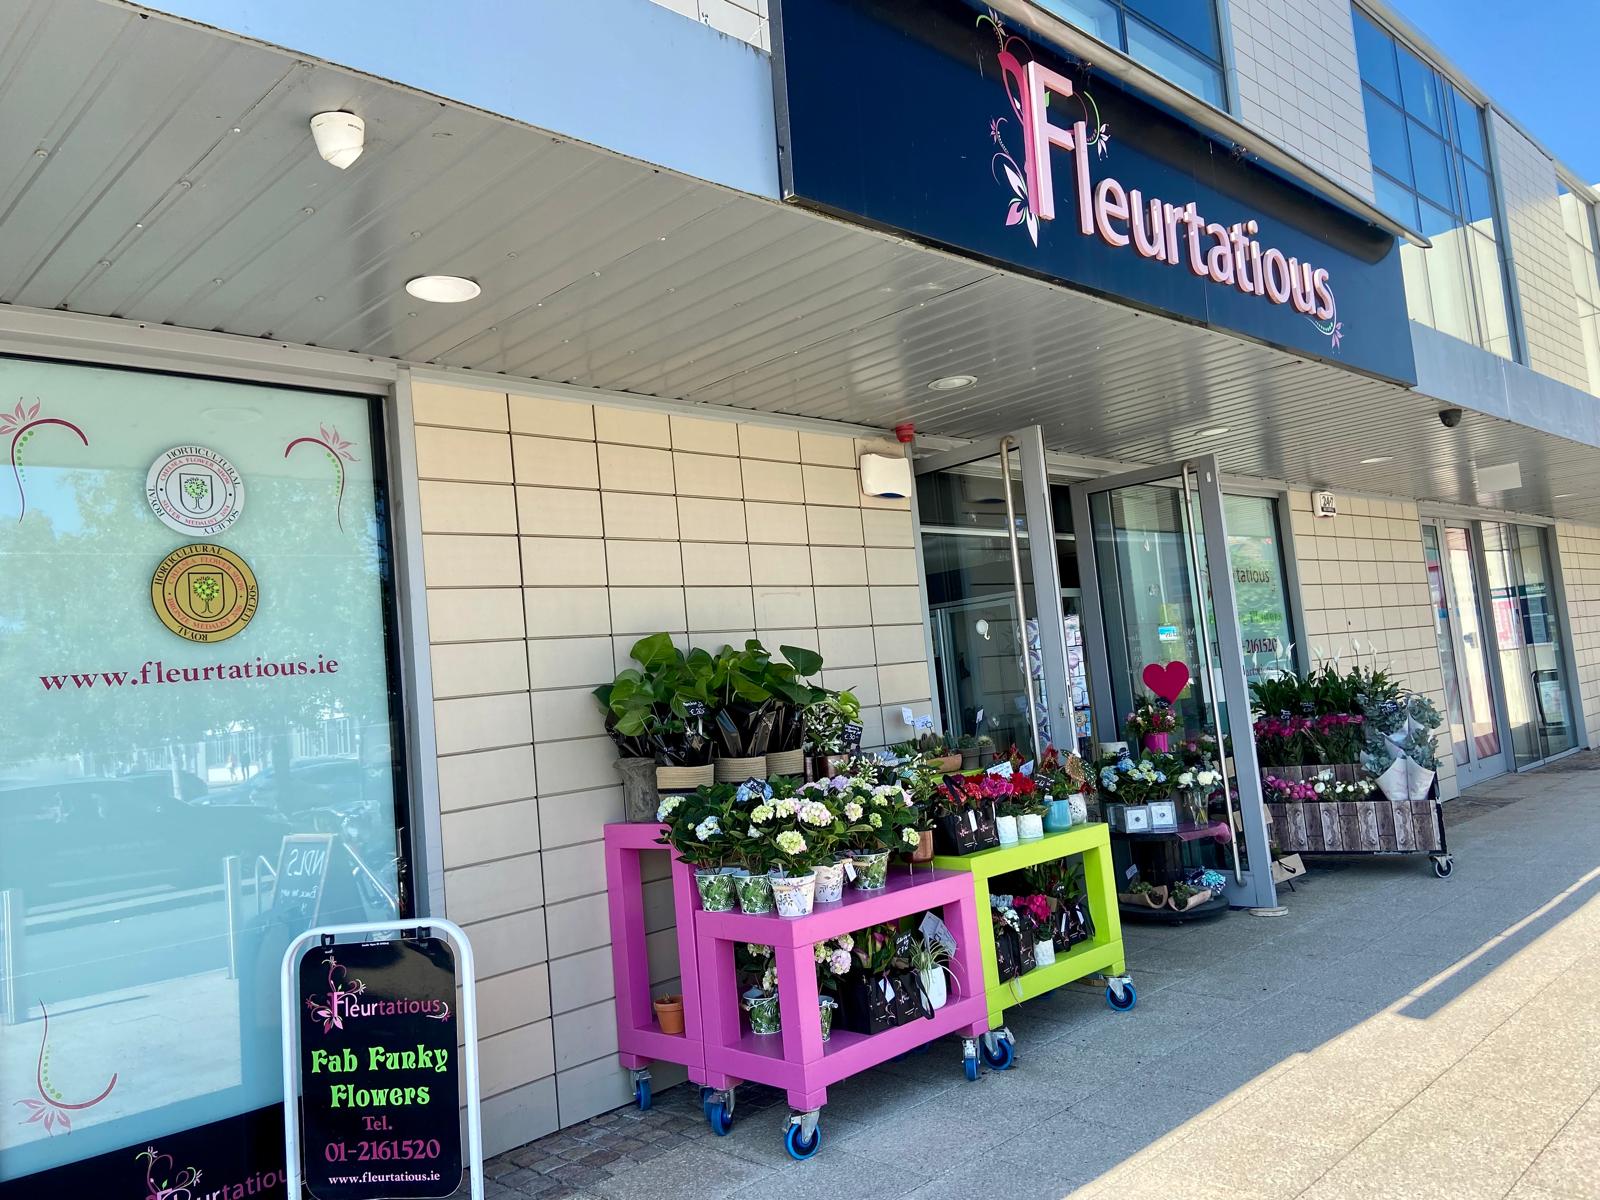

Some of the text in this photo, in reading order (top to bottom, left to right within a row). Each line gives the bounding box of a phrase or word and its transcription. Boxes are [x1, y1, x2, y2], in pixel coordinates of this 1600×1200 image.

[1018, 60, 1336, 320] Fleurtatious
[147, 446, 241, 535] ROYAL HORTICULTURAL SOCIETY
[1232, 565, 1270, 583] tatious
[154, 545, 257, 641] ROYAL HORTICULTURAL SOCIETY
[39, 653, 339, 691] www.fleurtatious.ie
[325, 991, 441, 1018] Fleurtatious
[311, 1044, 449, 1074] Fab Funky
[330, 1083, 431, 1108] Flowers
[361, 1115, 393, 1131] Tel.
[324, 1138, 441, 1162] 01-2161520
[328, 1170, 441, 1184] www.fleurtatious.ie
